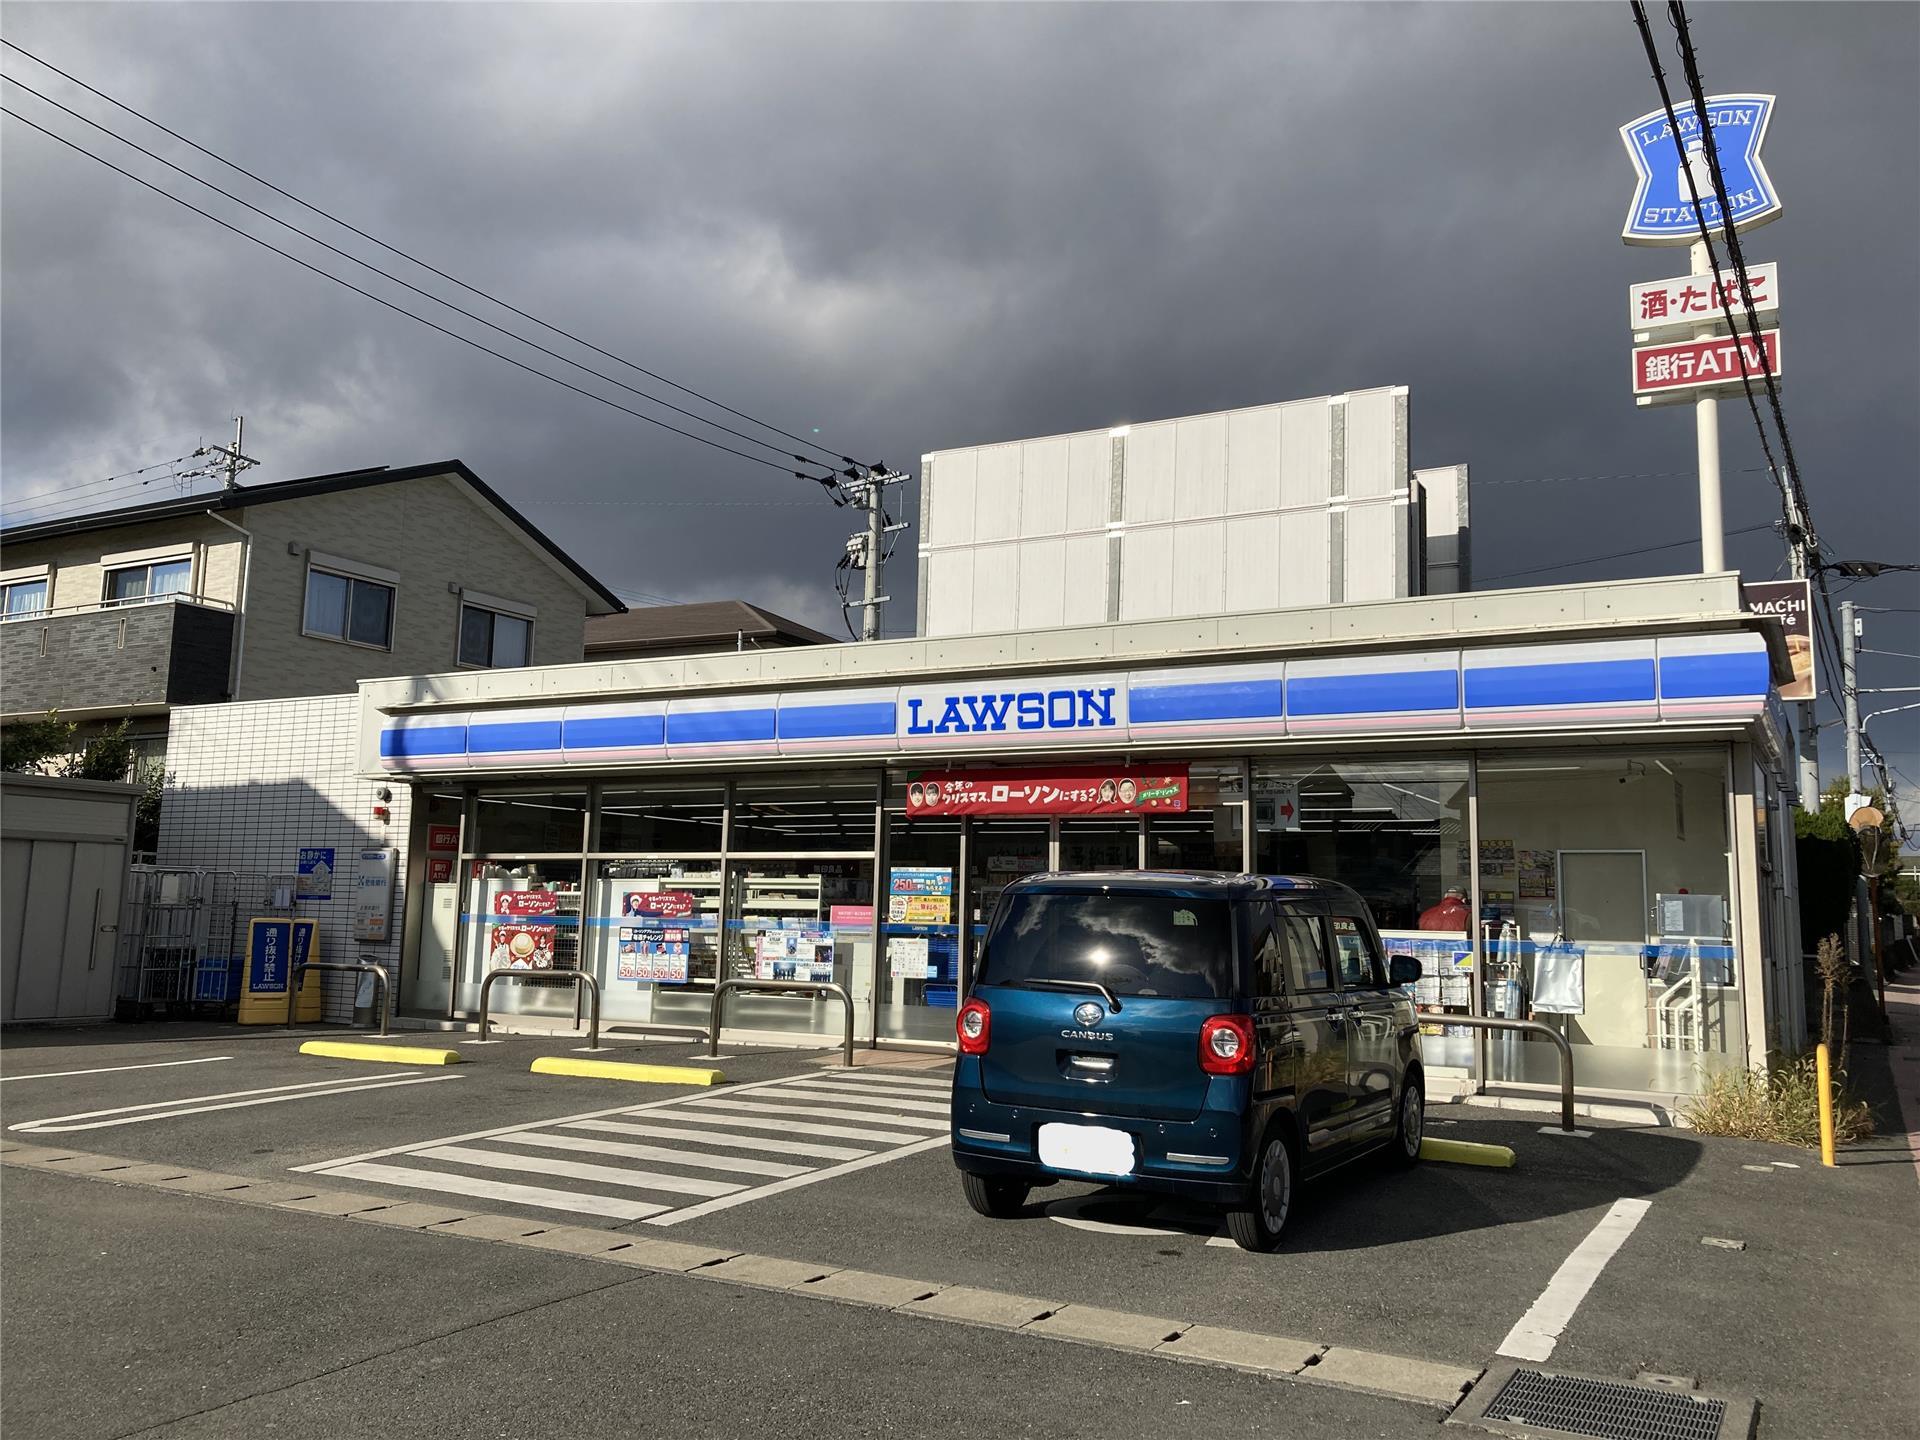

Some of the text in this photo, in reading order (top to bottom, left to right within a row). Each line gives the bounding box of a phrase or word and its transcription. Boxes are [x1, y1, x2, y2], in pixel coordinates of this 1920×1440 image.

[1640, 110, 1754, 146] LAWSON
[1640, 276, 1768, 319] 酒・たばこ
[1645, 343, 1768, 382] 銀行ATM
[1750, 599, 1806, 614] MACHI
[1780, 613, 1797, 626] fé
[907, 688, 1116, 735] LAWSON
[944, 780, 973, 792] 今年の
[435, 834, 459, 844] 銀行A
[1333, 921, 1357, 931] 印良品
[263, 927, 278, 982] 通り抜け禁止
[1061, 1029, 1114, 1041] CANBUS
